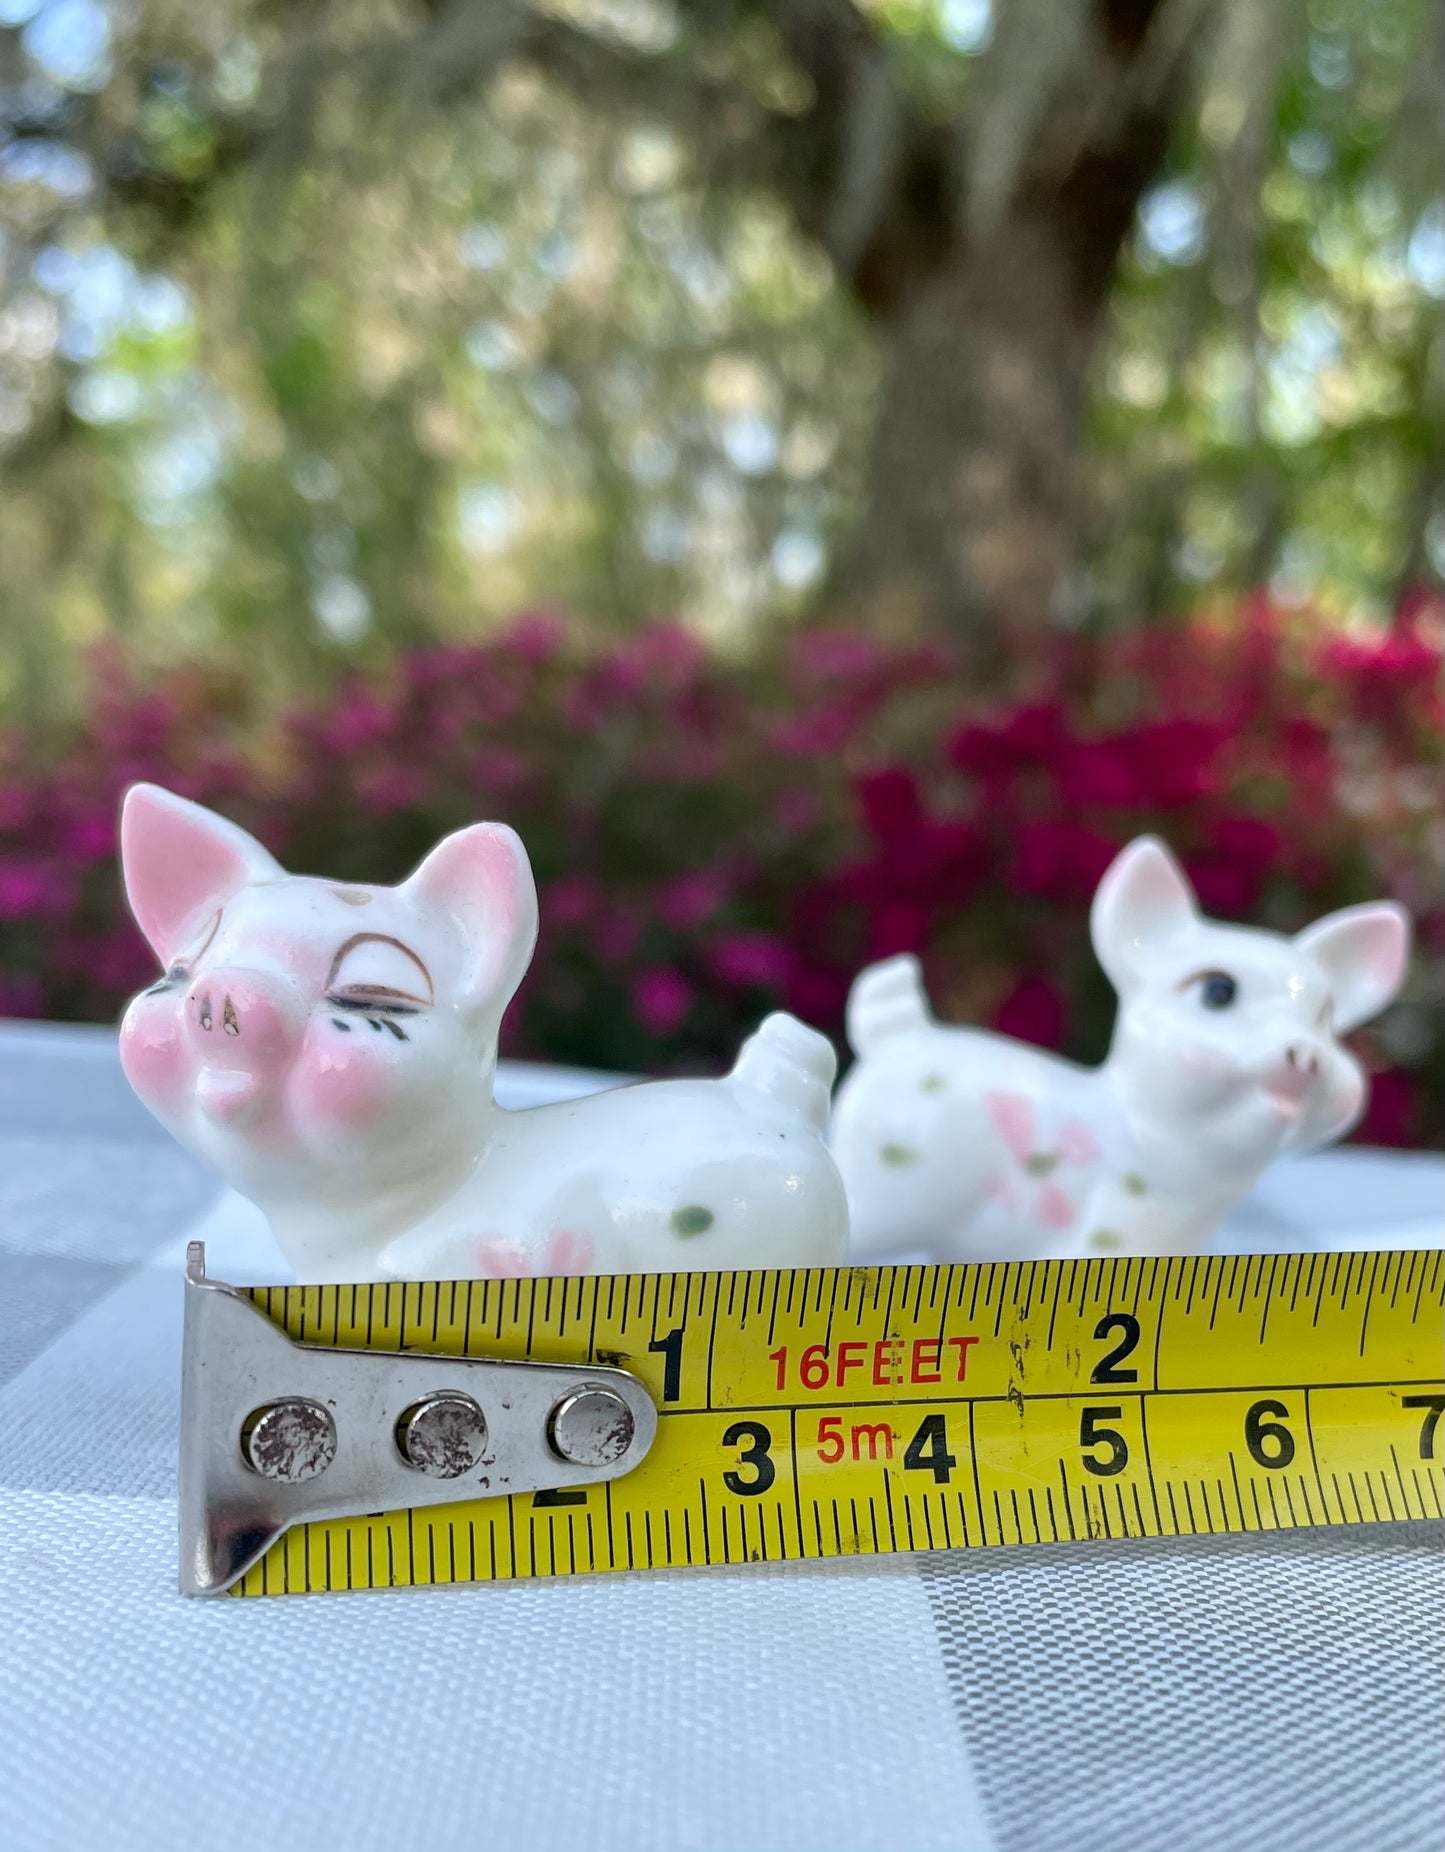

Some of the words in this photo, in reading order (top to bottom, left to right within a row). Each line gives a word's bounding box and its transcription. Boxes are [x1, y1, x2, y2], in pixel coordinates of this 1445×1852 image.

[648, 1328, 685, 1402] 1
[1090, 1313, 1141, 1385] 2
[721, 1421, 775, 1496] 3
[817, 1417, 894, 1465] 5m
[904, 1413, 956, 1484] 4
[1079, 1406, 1128, 1477] 5
[1245, 1399, 1296, 1470] 6
[1402, 1394, 1445, 1460] 7
